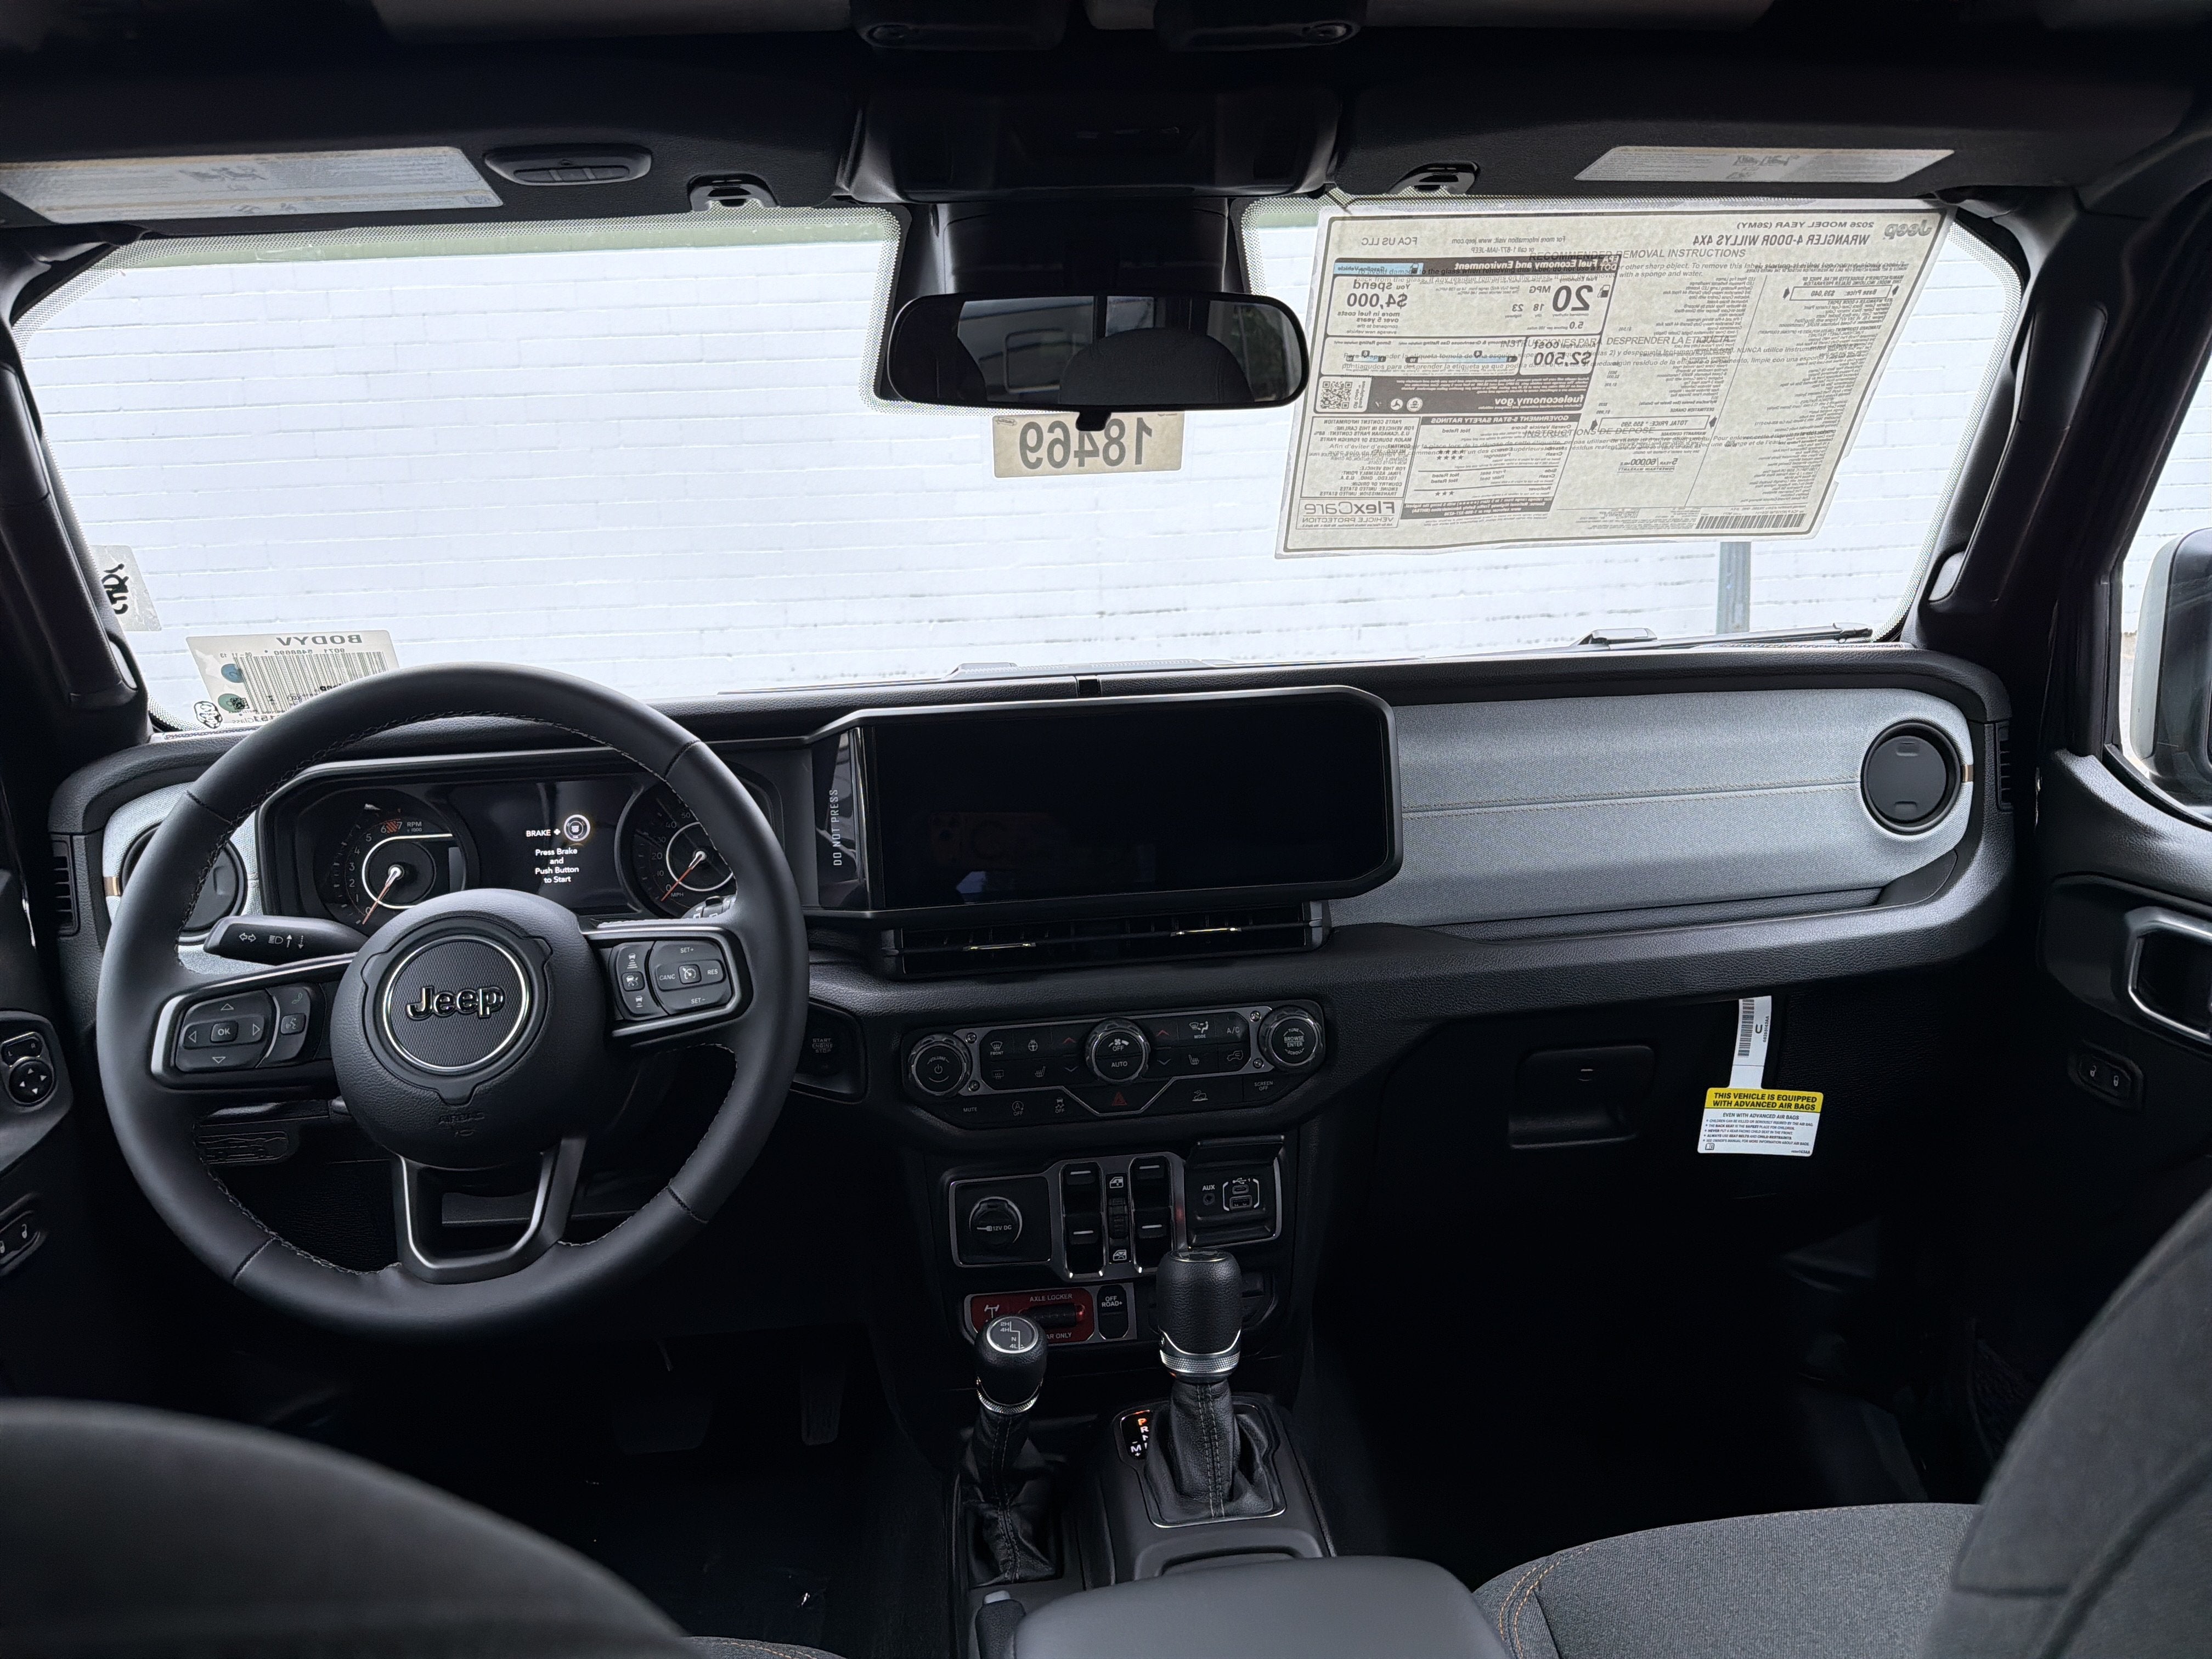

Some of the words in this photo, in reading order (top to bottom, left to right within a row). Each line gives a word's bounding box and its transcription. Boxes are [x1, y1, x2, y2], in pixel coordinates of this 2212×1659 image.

[1668, 249, 1746, 258] INSTRUCTIONS
[1606, 336, 1669, 345] DESPRENDER
[1673, 336, 1684, 344] LA
[830, 789, 840, 823] PRESS
[381, 825, 387, 833] 6
[366, 833, 372, 842] 5
[832, 827, 840, 848] NOT
[354, 847, 360, 855] 4
[833, 852, 842, 866] DO
[348, 862, 355, 871] 3
[555, 866, 579, 874] Button
[349, 879, 355, 887] 2
[406, 985, 505, 1021] Jeep
[218, 1028, 230, 1036] OK
[1755, 1024, 1763, 1034] U
[1777, 1094, 1817, 1103] EQUIPPED
[1794, 1103, 1815, 1111] BAGS
[1131, 1444, 1142, 1453] M
